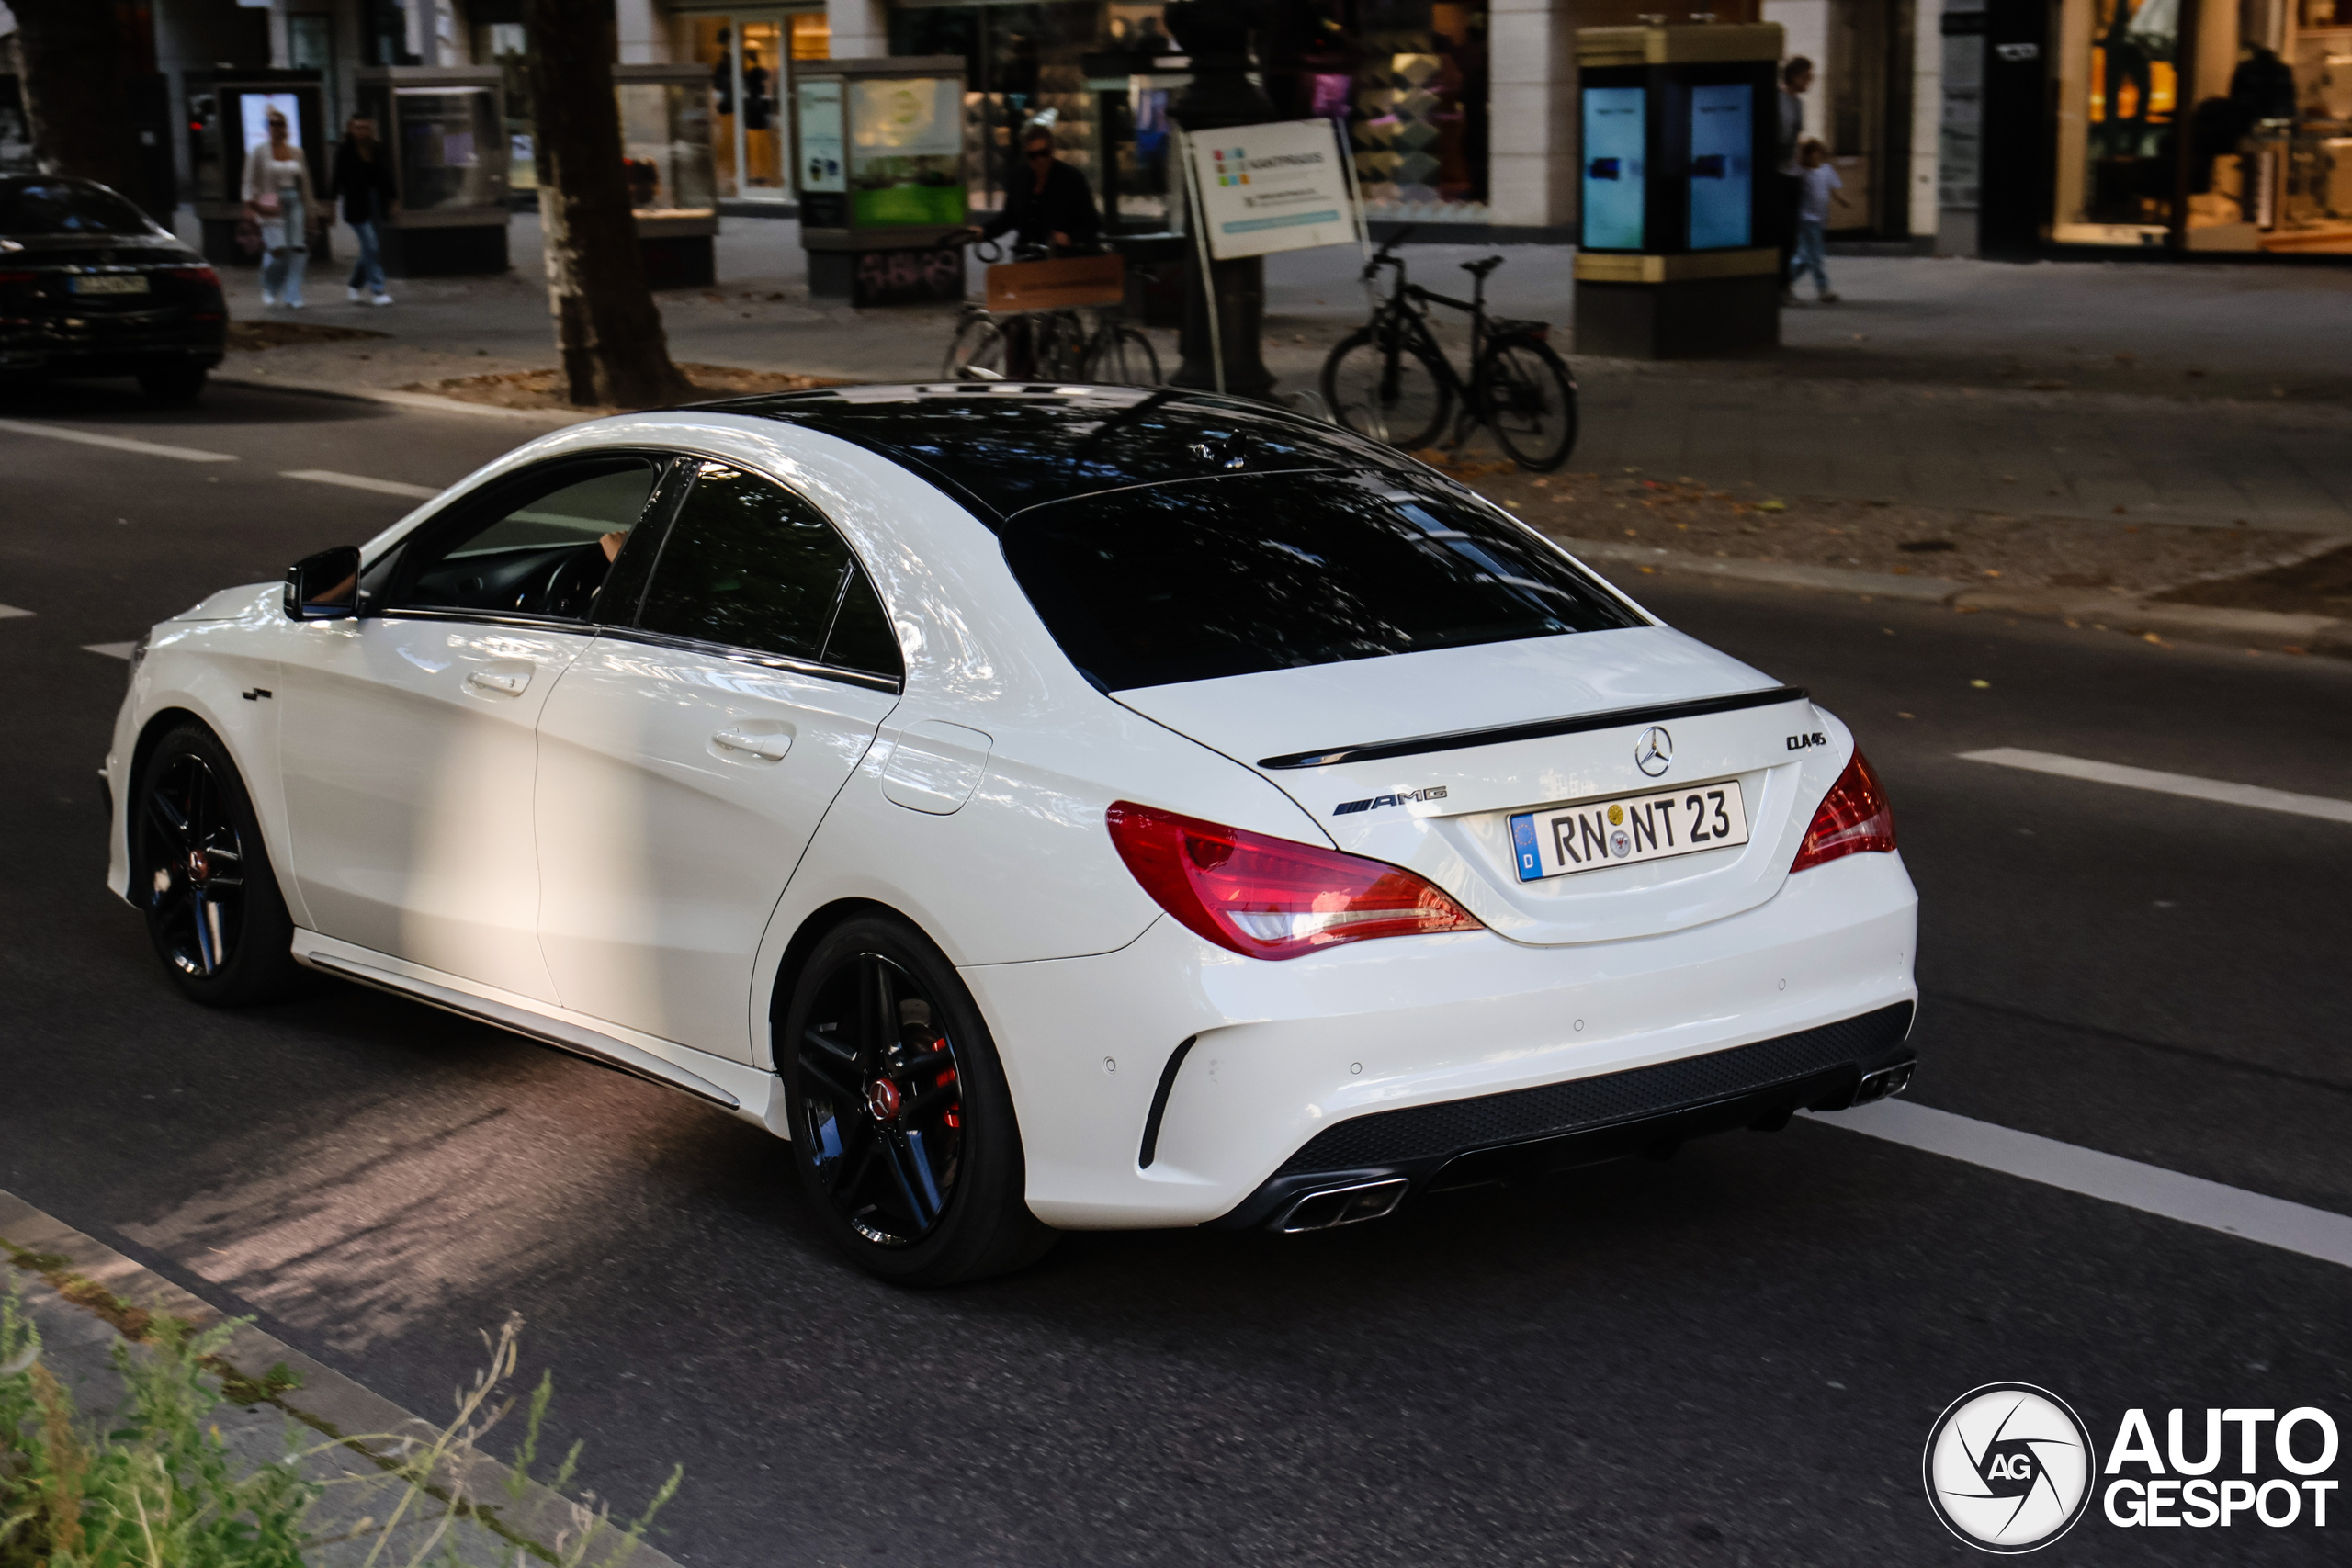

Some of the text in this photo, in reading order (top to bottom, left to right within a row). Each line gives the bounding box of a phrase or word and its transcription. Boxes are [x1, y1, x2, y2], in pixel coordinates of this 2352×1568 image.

[1370, 785, 1448, 809] AMG
[1551, 789, 1730, 866] RN NT 23
[1523, 853, 1533, 869] D
